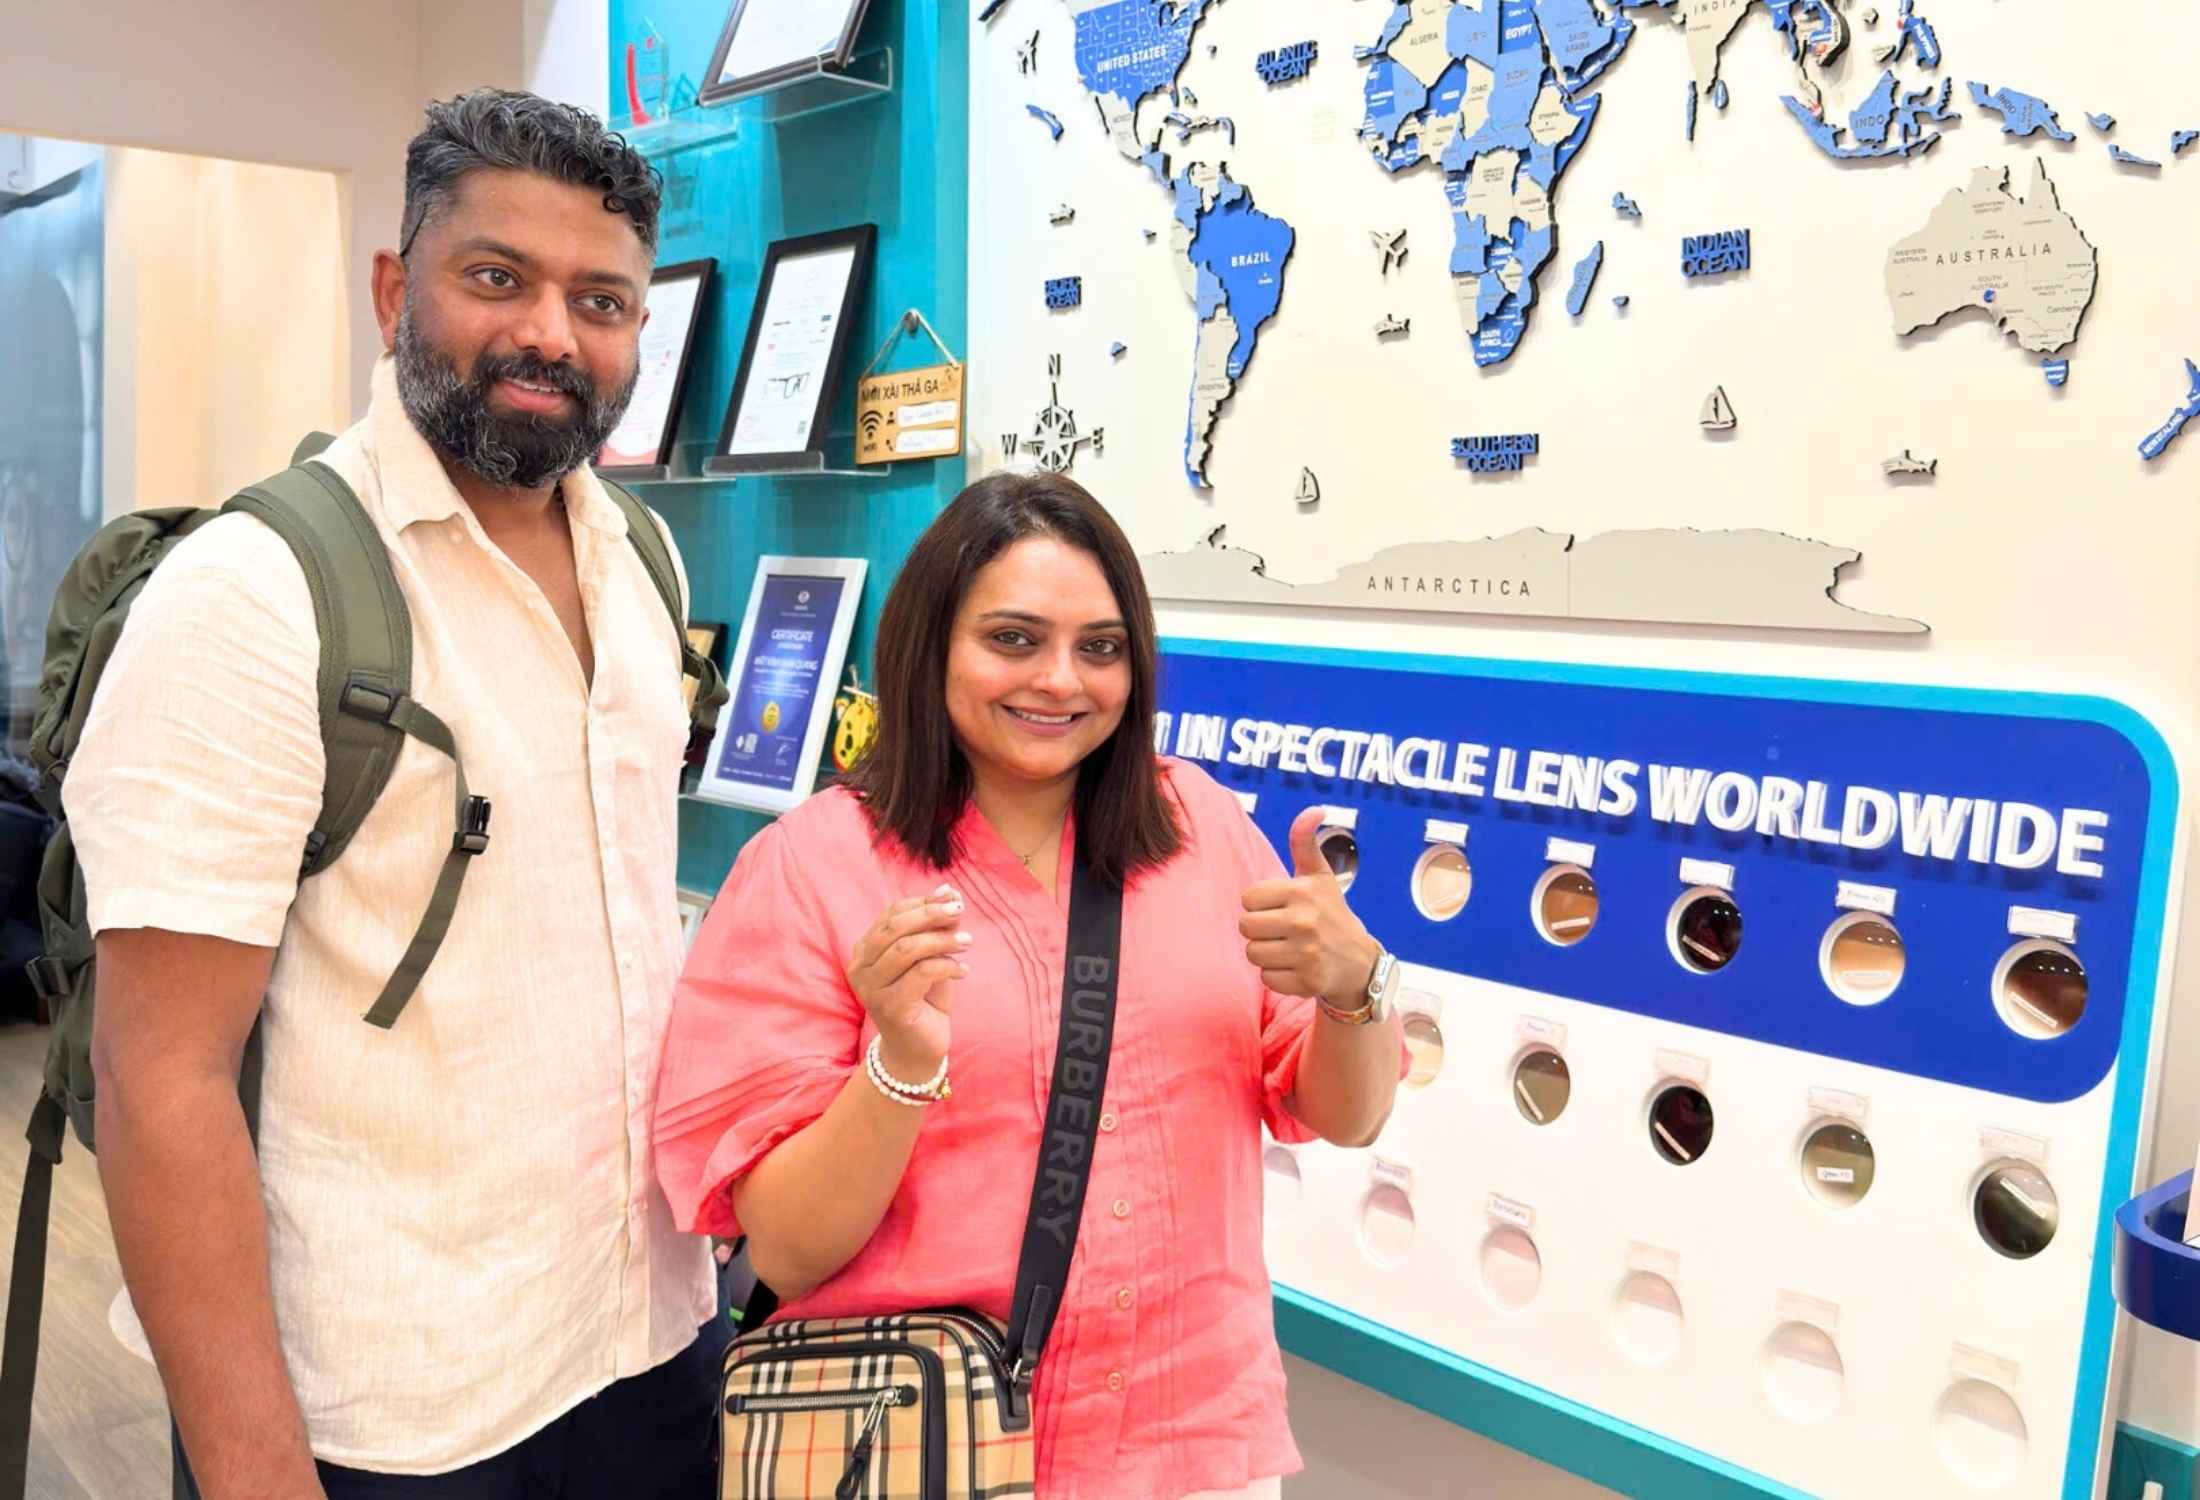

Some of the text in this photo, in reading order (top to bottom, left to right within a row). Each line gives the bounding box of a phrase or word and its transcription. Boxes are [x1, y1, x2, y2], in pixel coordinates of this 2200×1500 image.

[1694, 0, 1736, 14] INDIA
[1097, 45, 1167, 73] UNITED STATES
[1260, 59, 1310, 85] OCEAN
[1855, 114, 1885, 128] INDO
[1682, 228, 1750, 259] INDIAN
[1936, 242, 2052, 266] AUSTRALIA
[1231, 251, 1271, 267] BRAZIL
[1682, 250, 1750, 278] OCEAN
[1049, 353, 1061, 376] N
[924, 379, 940, 394] GA
[1001, 433, 1017, 456] W
[1092, 427, 1104, 450] E
[1451, 433, 1539, 457] SOUTHERN
[1468, 453, 1523, 473] OCEAN
[1367, 576, 1530, 596] ANTARCTICA
[1175, 712, 1228, 763] IN
[1227, 717, 1490, 797] SPECTACLE
[1492, 746, 1640, 817] LENS
[1647, 763, 2109, 878] WORLDWIDE
[1036, 955, 1110, 1247] BURBERRY
